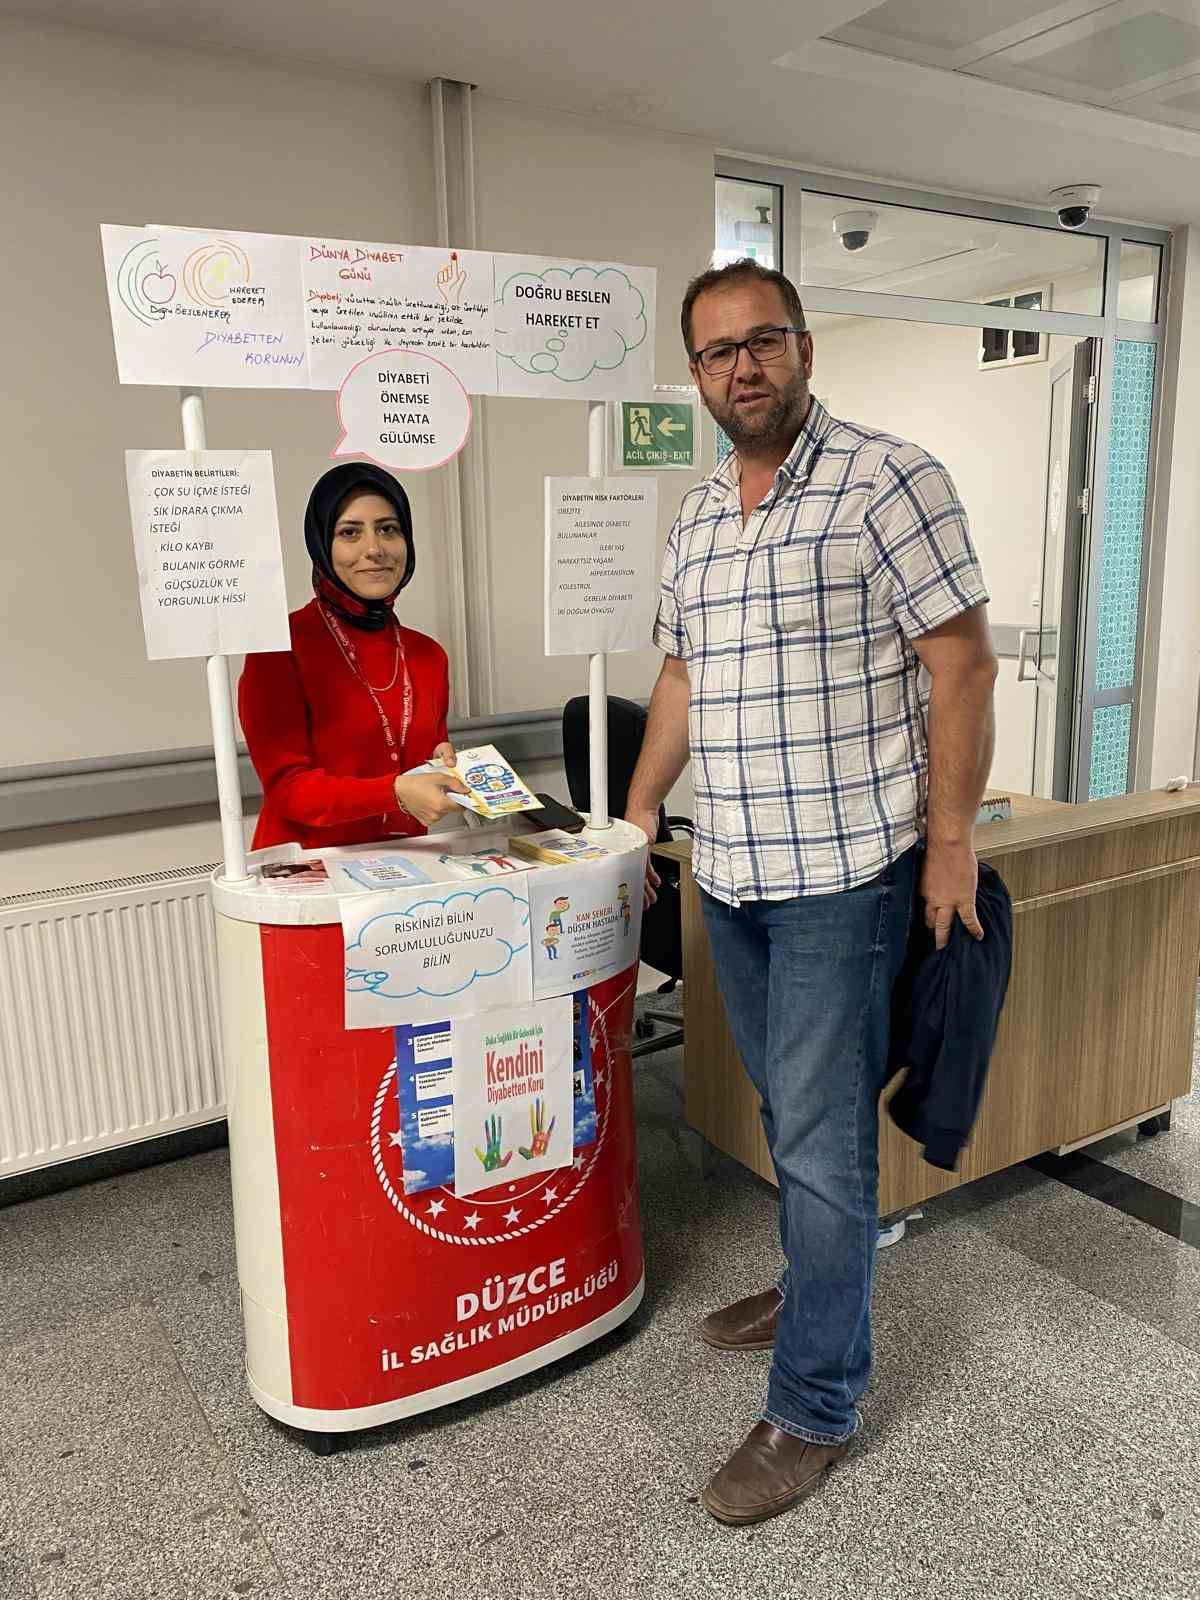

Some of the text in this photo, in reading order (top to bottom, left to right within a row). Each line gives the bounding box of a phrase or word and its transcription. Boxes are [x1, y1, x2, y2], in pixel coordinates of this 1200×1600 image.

[309, 244, 350, 261] DÜNYA
[338, 267, 372, 281] GÜNÜ
[229, 286, 266, 295] HAREKET
[515, 284, 610, 304] DOĞRU BESLEN
[526, 313, 600, 330] HAREKET ET
[245, 351, 305, 367] KORUNUN
[378, 370, 430, 385] DİYABETİ
[380, 390, 430, 404] ÖNEMSE
[383, 413, 430, 425] HAYATA
[380, 431, 437, 444] GÜLÜMSE
[625, 450, 645, 460] ACİL
[673, 450, 691, 460] EXIT
[151, 468, 193, 478] DİYABETİN
[154, 484, 251, 499] ÇOK SU İÇME İSTEĞİ
[562, 493, 594, 501] DİYABETİN
[171, 504, 209, 516] İDRARA
[210, 505, 243, 517] ÇIKMA
[150, 521, 181, 533] İSTEĞİ
[160, 541, 214, 552] KİLO KAYBI
[162, 558, 246, 571] BULANIK GÖRME
[165, 577, 239, 591] GÜÇSÜZLÜK VE
[158, 592, 246, 606] YORGUNLUK HİSSİ
[394, 911, 475, 934] RİSKİNİZİ BİLİN
[575, 911, 590, 922] KAN
[375, 927, 494, 957] SORUMLULUĞUNUZU
[422, 953, 451, 969] BİLİN
[486, 1039, 544, 1085] Kendini
[487, 1076, 544, 1105] Diyabetten Koru
[456, 1257, 566, 1323] DÜZCE
[381, 1259, 619, 1372] İL SAĞLIK MÜDÜRLÜĞÜ
